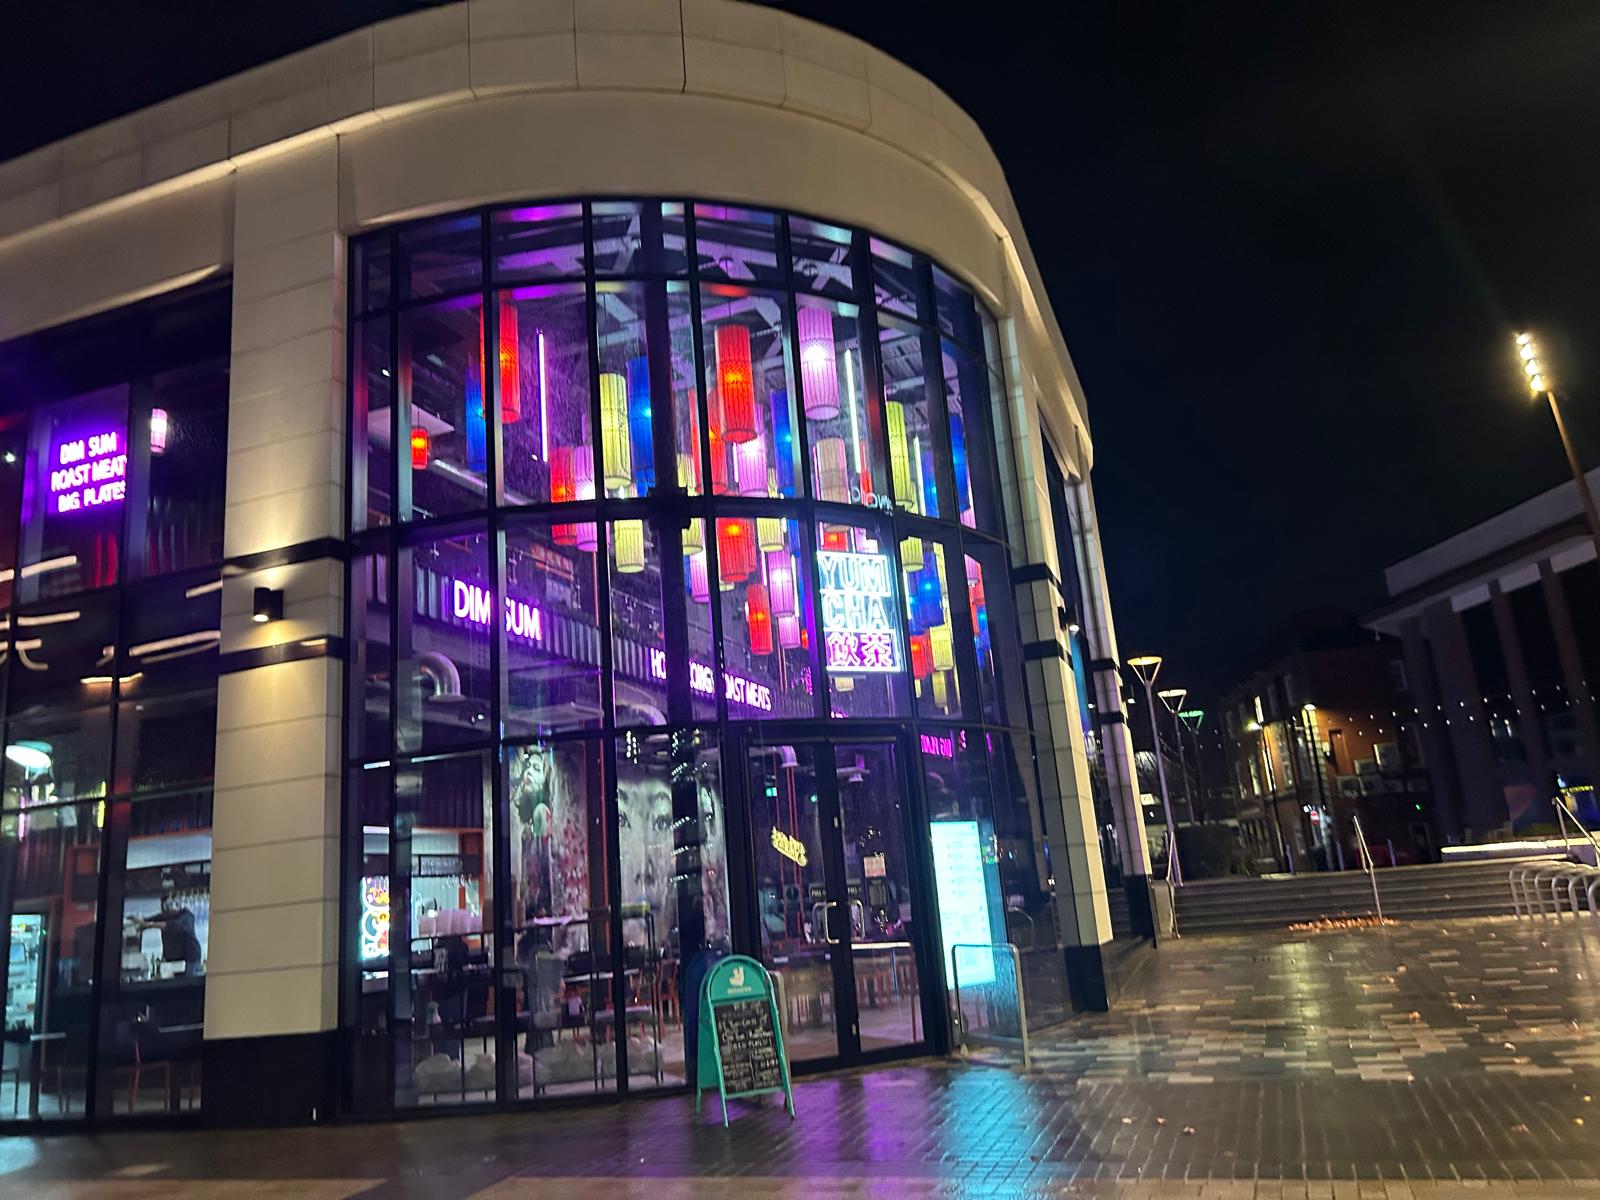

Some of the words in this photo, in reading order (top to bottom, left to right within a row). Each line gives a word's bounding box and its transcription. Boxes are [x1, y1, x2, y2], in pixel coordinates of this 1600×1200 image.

[60, 440, 84, 464] DIM
[88, 432, 116, 457] SUM
[51, 464, 91, 491] ROAST
[92, 455, 127, 481] MEAT
[58, 492, 80, 512] BIG
[819, 555, 889, 594] YUM
[454, 580, 491, 625] DIM
[822, 593, 889, 630] CHA
[826, 632, 892, 667] 飲茶
[745, 681, 771, 712] MEATS
